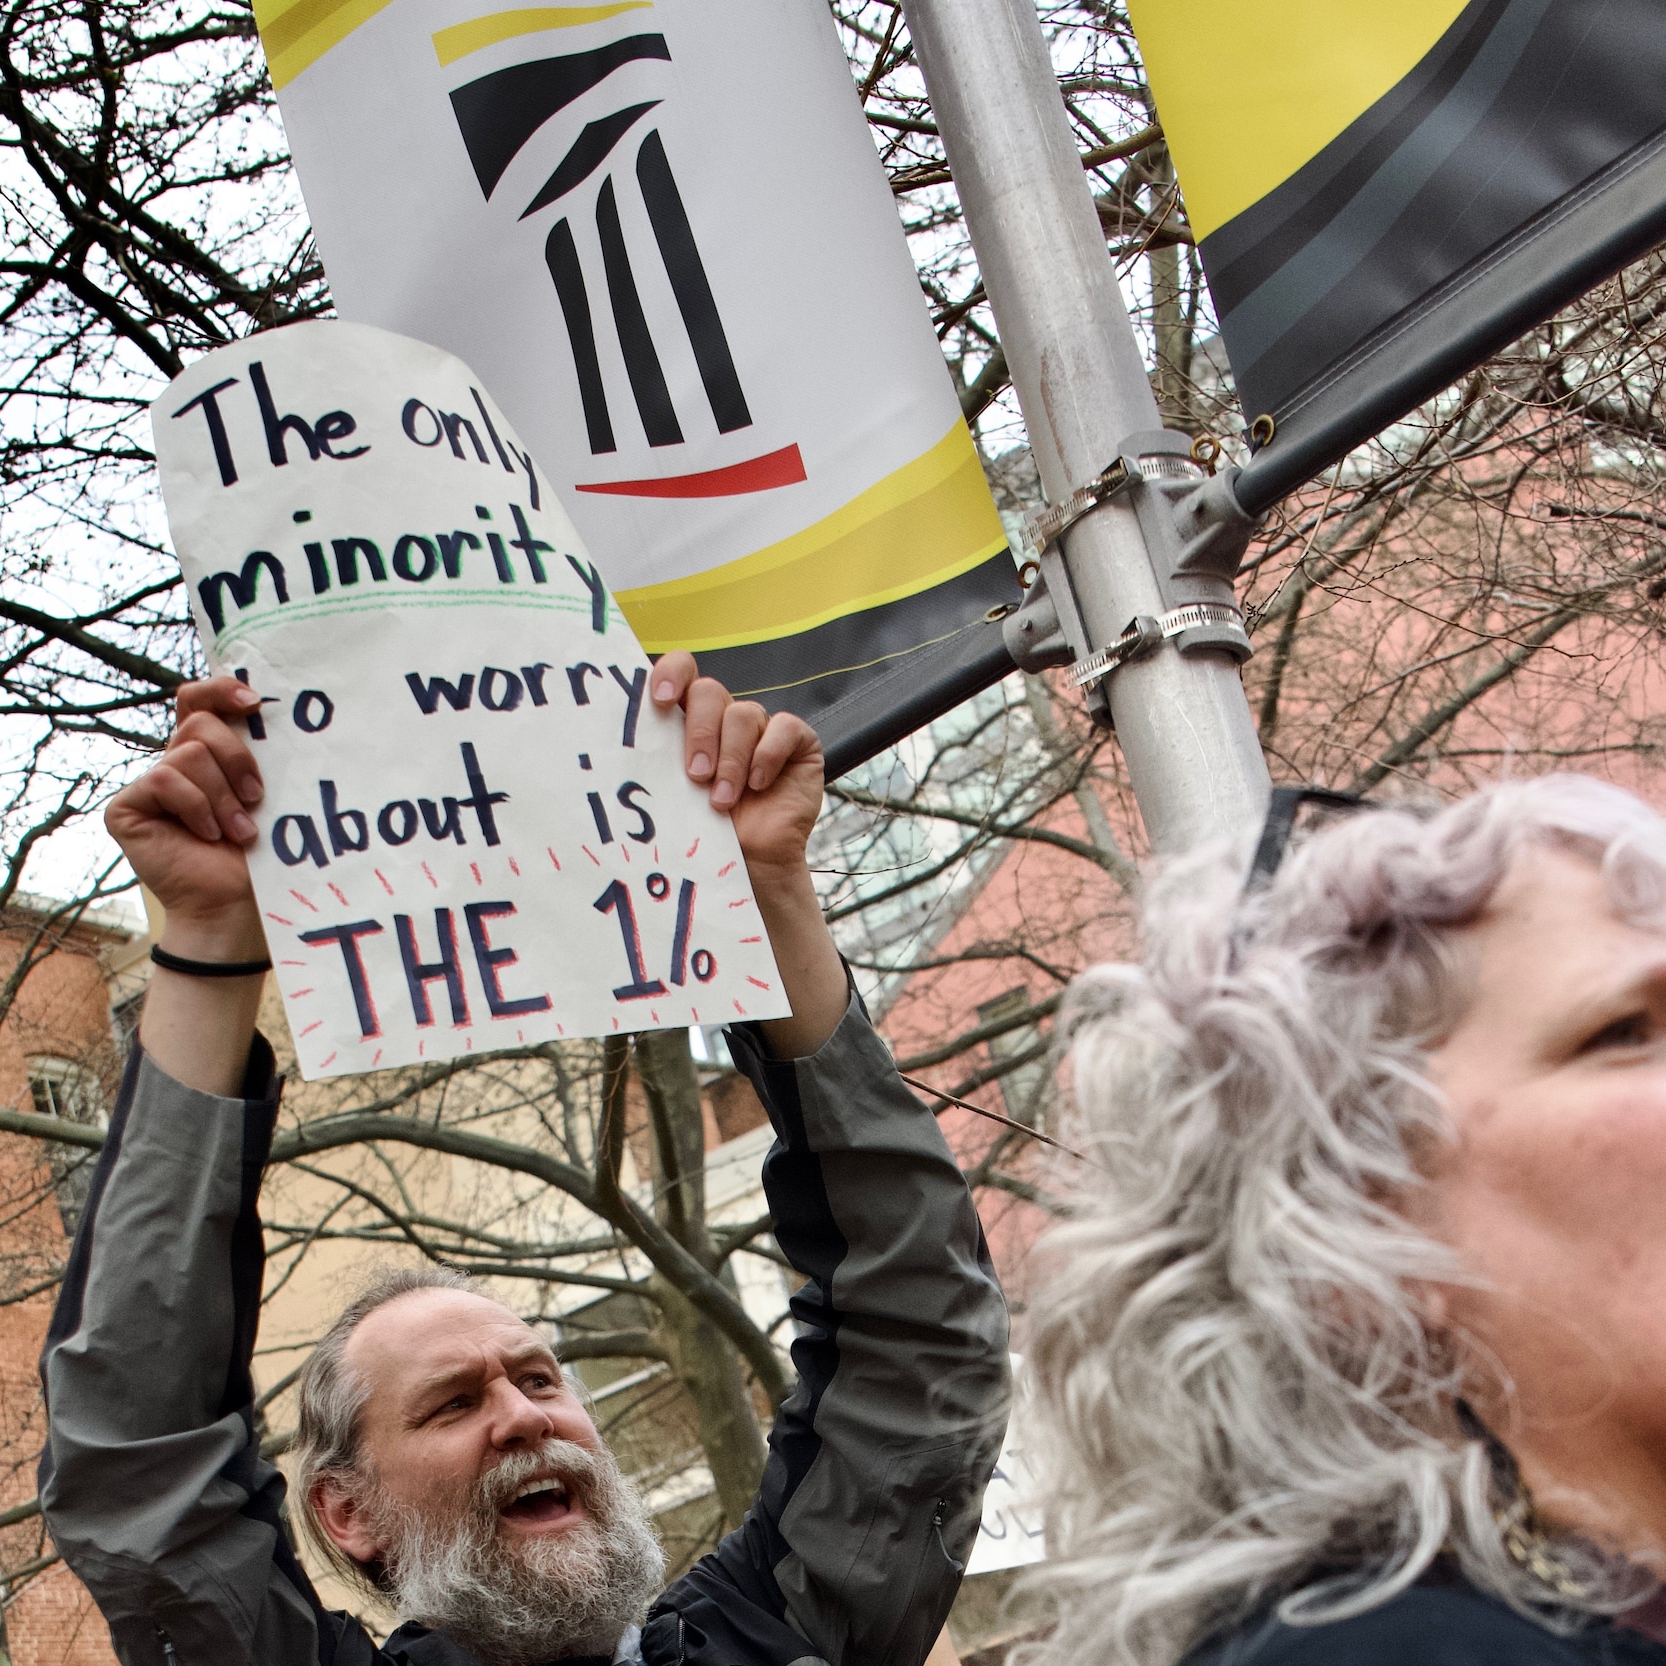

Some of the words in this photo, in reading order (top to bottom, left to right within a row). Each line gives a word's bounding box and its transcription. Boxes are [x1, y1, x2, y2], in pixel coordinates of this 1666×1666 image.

[171, 361, 371, 487] The
[402, 387, 541, 510] only
[197, 503, 607, 635] minority
[405, 664, 649, 748] worry
[271, 742, 510, 868] about
[578, 754, 655, 844] is
[298, 900, 552, 1041] THE
[593, 871, 717, 1002] 1%
